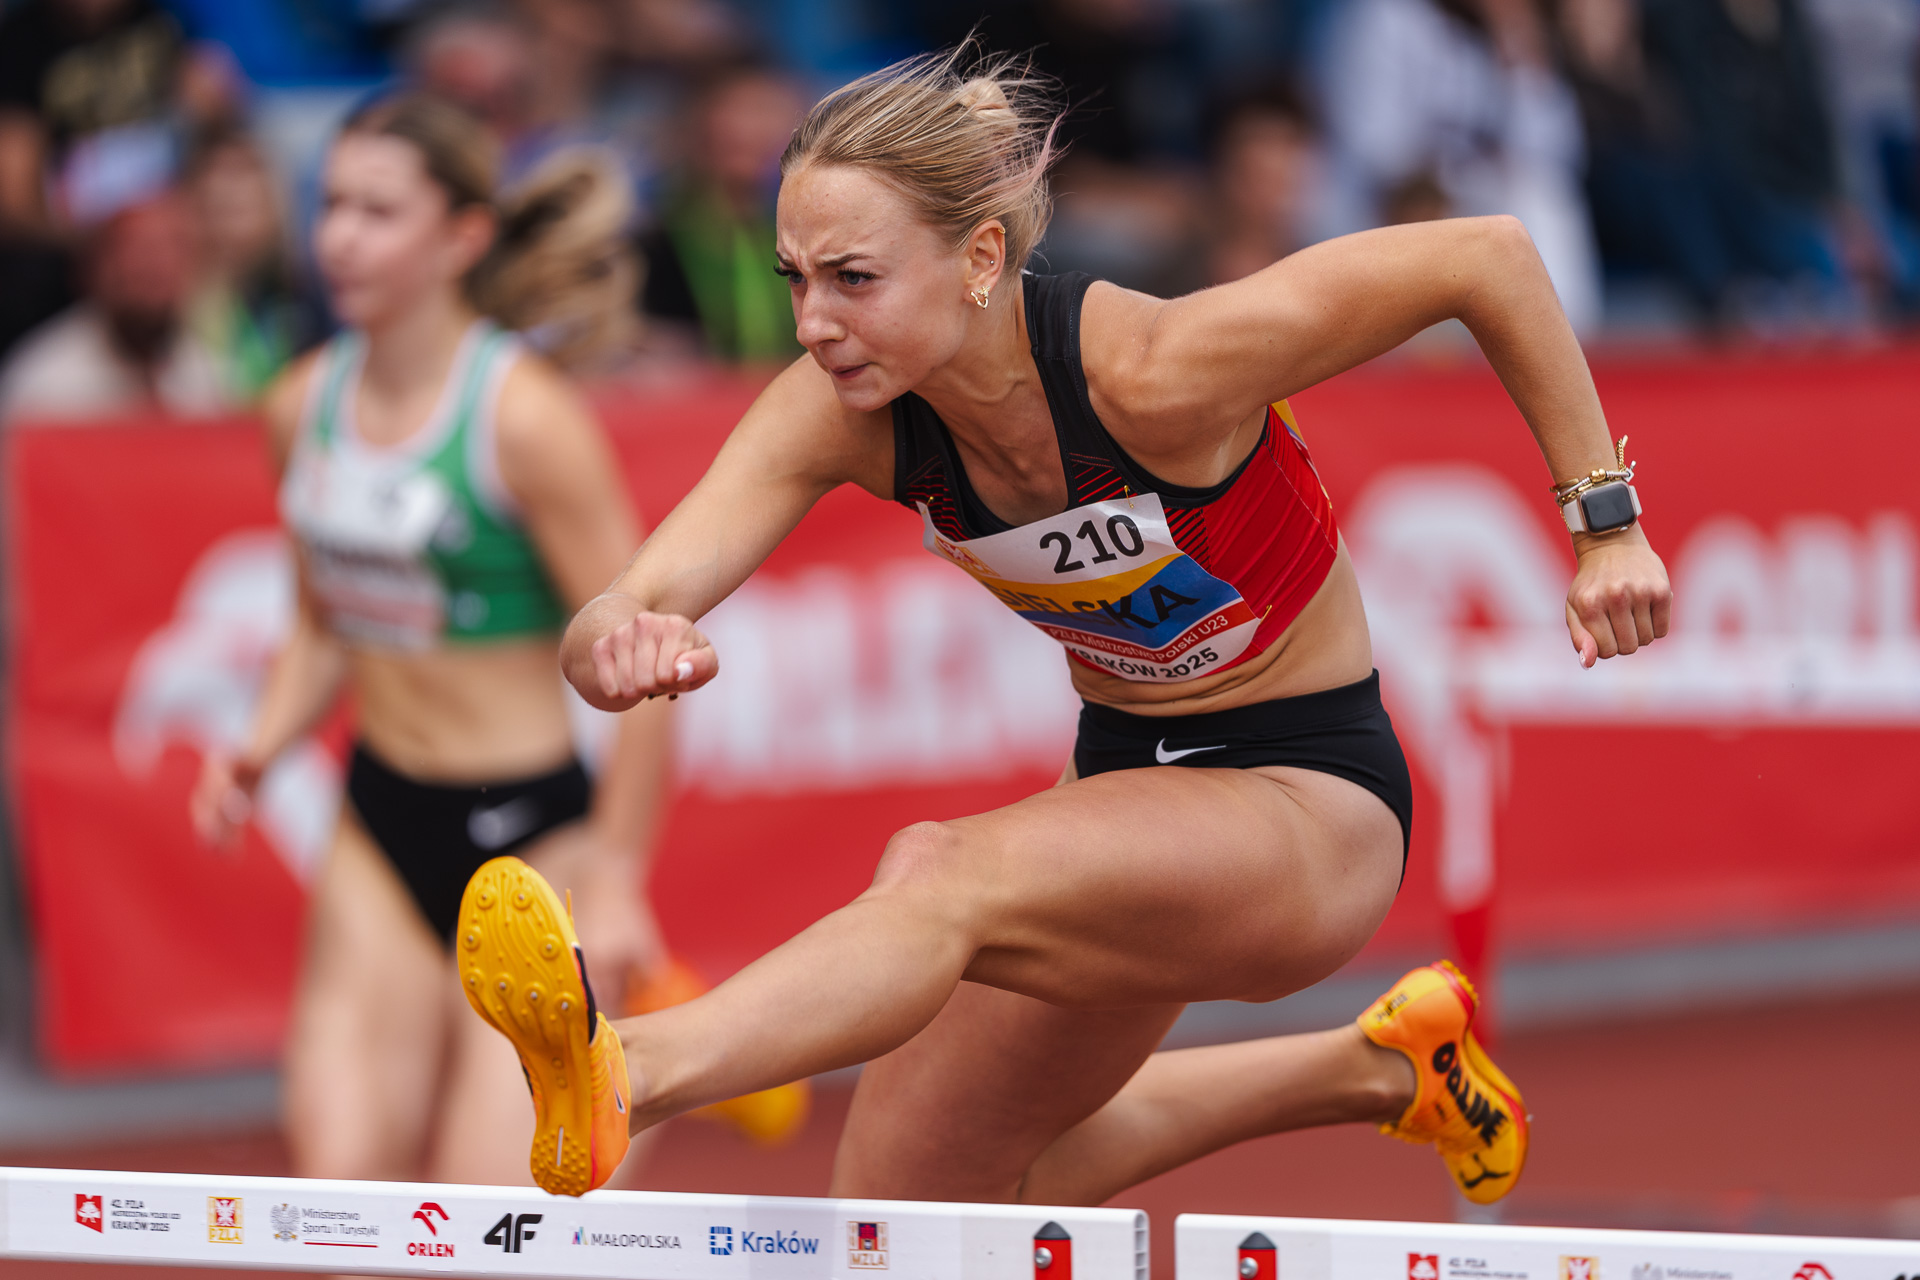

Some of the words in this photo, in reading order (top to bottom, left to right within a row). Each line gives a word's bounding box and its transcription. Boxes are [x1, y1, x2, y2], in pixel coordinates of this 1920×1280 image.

[1039, 514, 1144, 574] 210
[1049, 627, 1082, 643] PZLA
[1080, 633, 1157, 661] Mistrzostwa
[1155, 631, 1199, 662] Polski
[1198, 614, 1229, 636] U23
[1159, 646, 1219, 678] 2025
[302, 1207, 361, 1221] Ministerstwo
[111, 1219, 148, 1231] KRAKÓW
[150, 1222, 170, 1232] 2025
[302, 1221, 332, 1235] Sportu
[338, 1223, 380, 1238] Turystyki
[483, 1212, 544, 1254] 4F
[208, 1227, 243, 1242] PZLA
[591, 1232, 683, 1250] MAŁOPOLSKA
[741, 1229, 820, 1255] Kraków
[407, 1242, 455, 1258] ORLEN
[850, 1252, 888, 1267] MZLA
